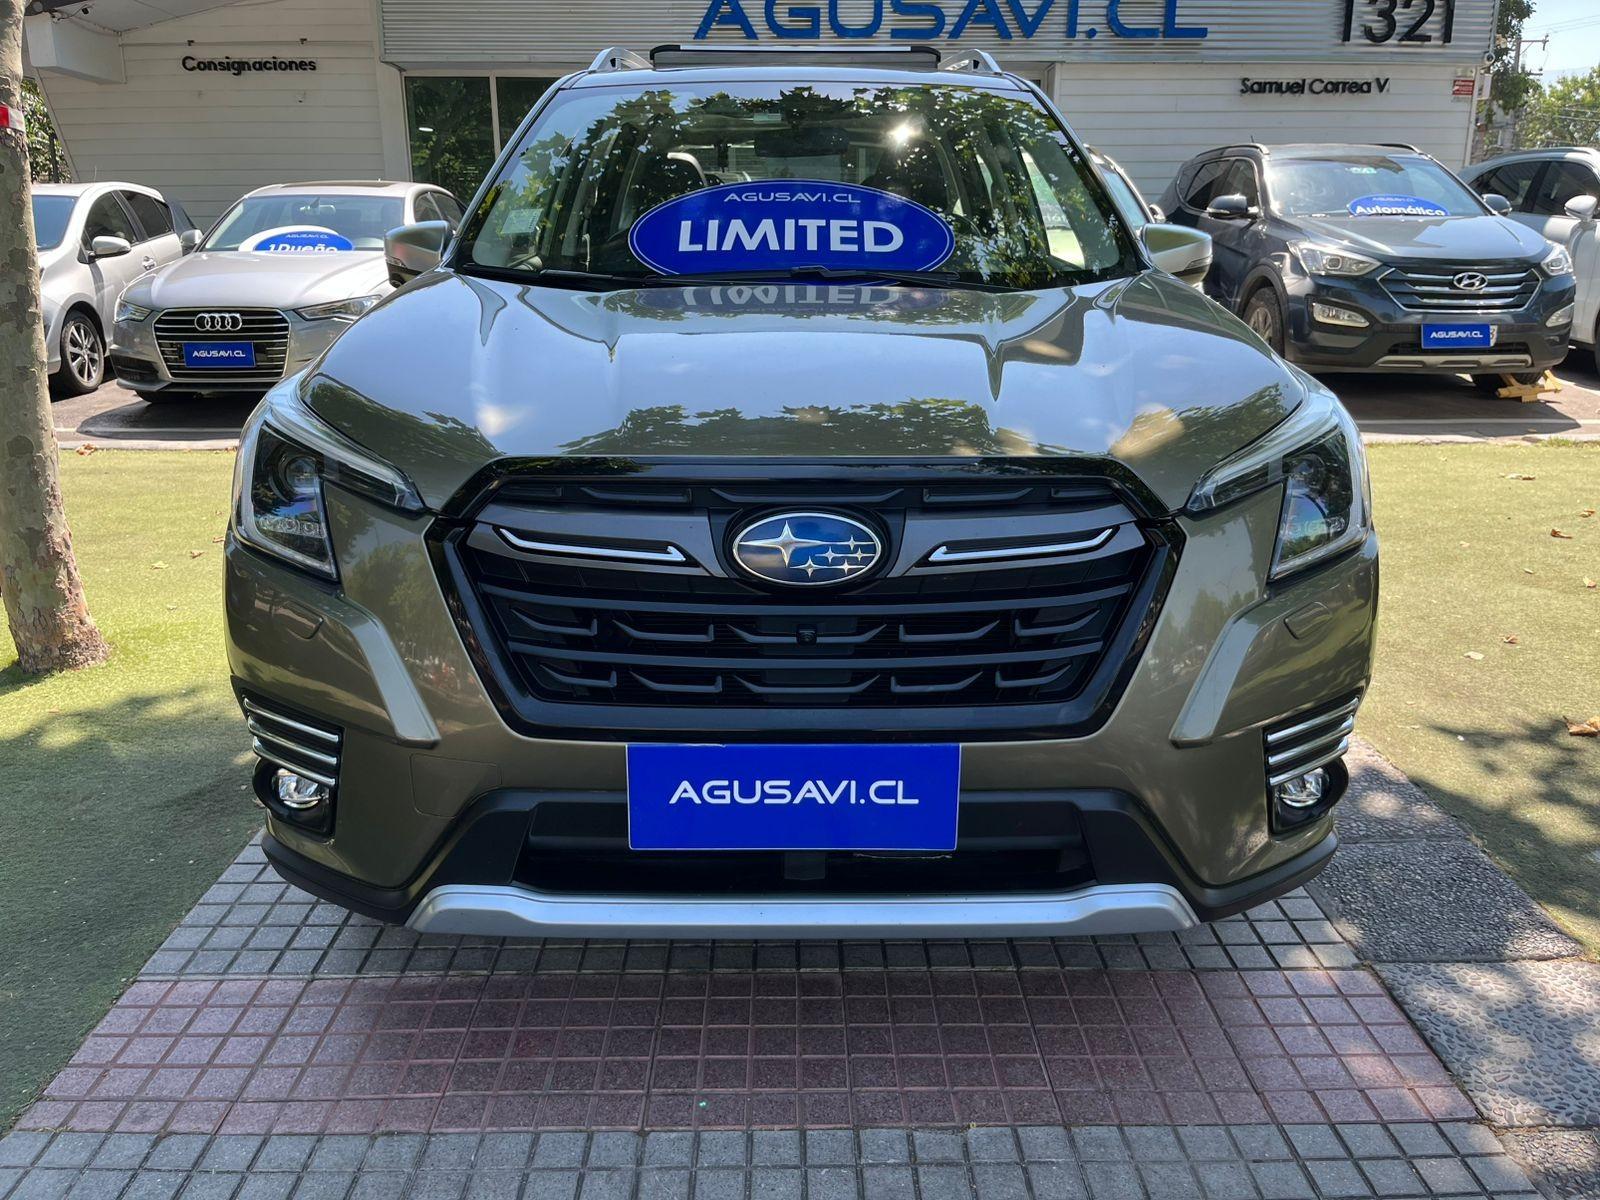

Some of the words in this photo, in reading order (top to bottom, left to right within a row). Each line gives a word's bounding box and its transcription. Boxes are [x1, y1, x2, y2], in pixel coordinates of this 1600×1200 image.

[693, 0, 1208, 40] AGUSAVI.CL
[1342, 0, 1456, 43] 1321
[181, 56, 317, 76] Consignaciones
[1240, 77, 1306, 94] Samuel
[1308, 78, 1372, 94] Correa
[723, 192, 861, 203] AGUSAVI.CL
[1355, 205, 1446, 216] Automático
[678, 218, 905, 253] LIMITED
[1430, 330, 1484, 338] AGUSAVI.CL
[669, 780, 920, 805] AGUSAVI.CL
